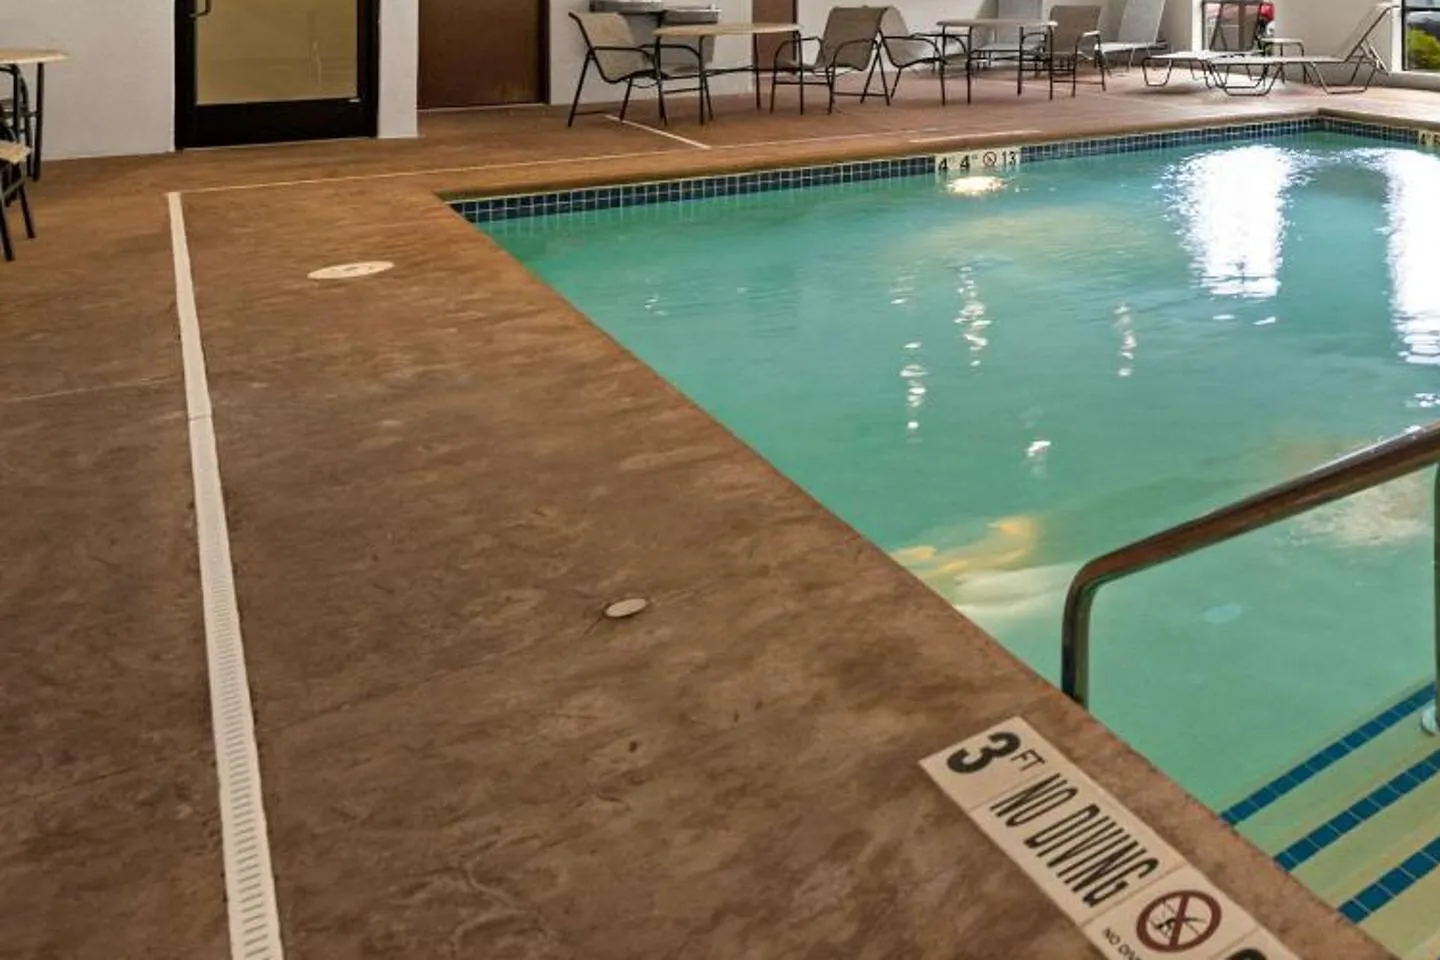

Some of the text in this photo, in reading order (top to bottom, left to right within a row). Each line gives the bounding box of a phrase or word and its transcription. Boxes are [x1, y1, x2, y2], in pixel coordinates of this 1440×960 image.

[938, 156, 949, 171] 4
[960, 155, 970, 169] 4
[946, 732, 1046, 774] 3 FT
[989, 773, 1159, 907] NO DIVING
